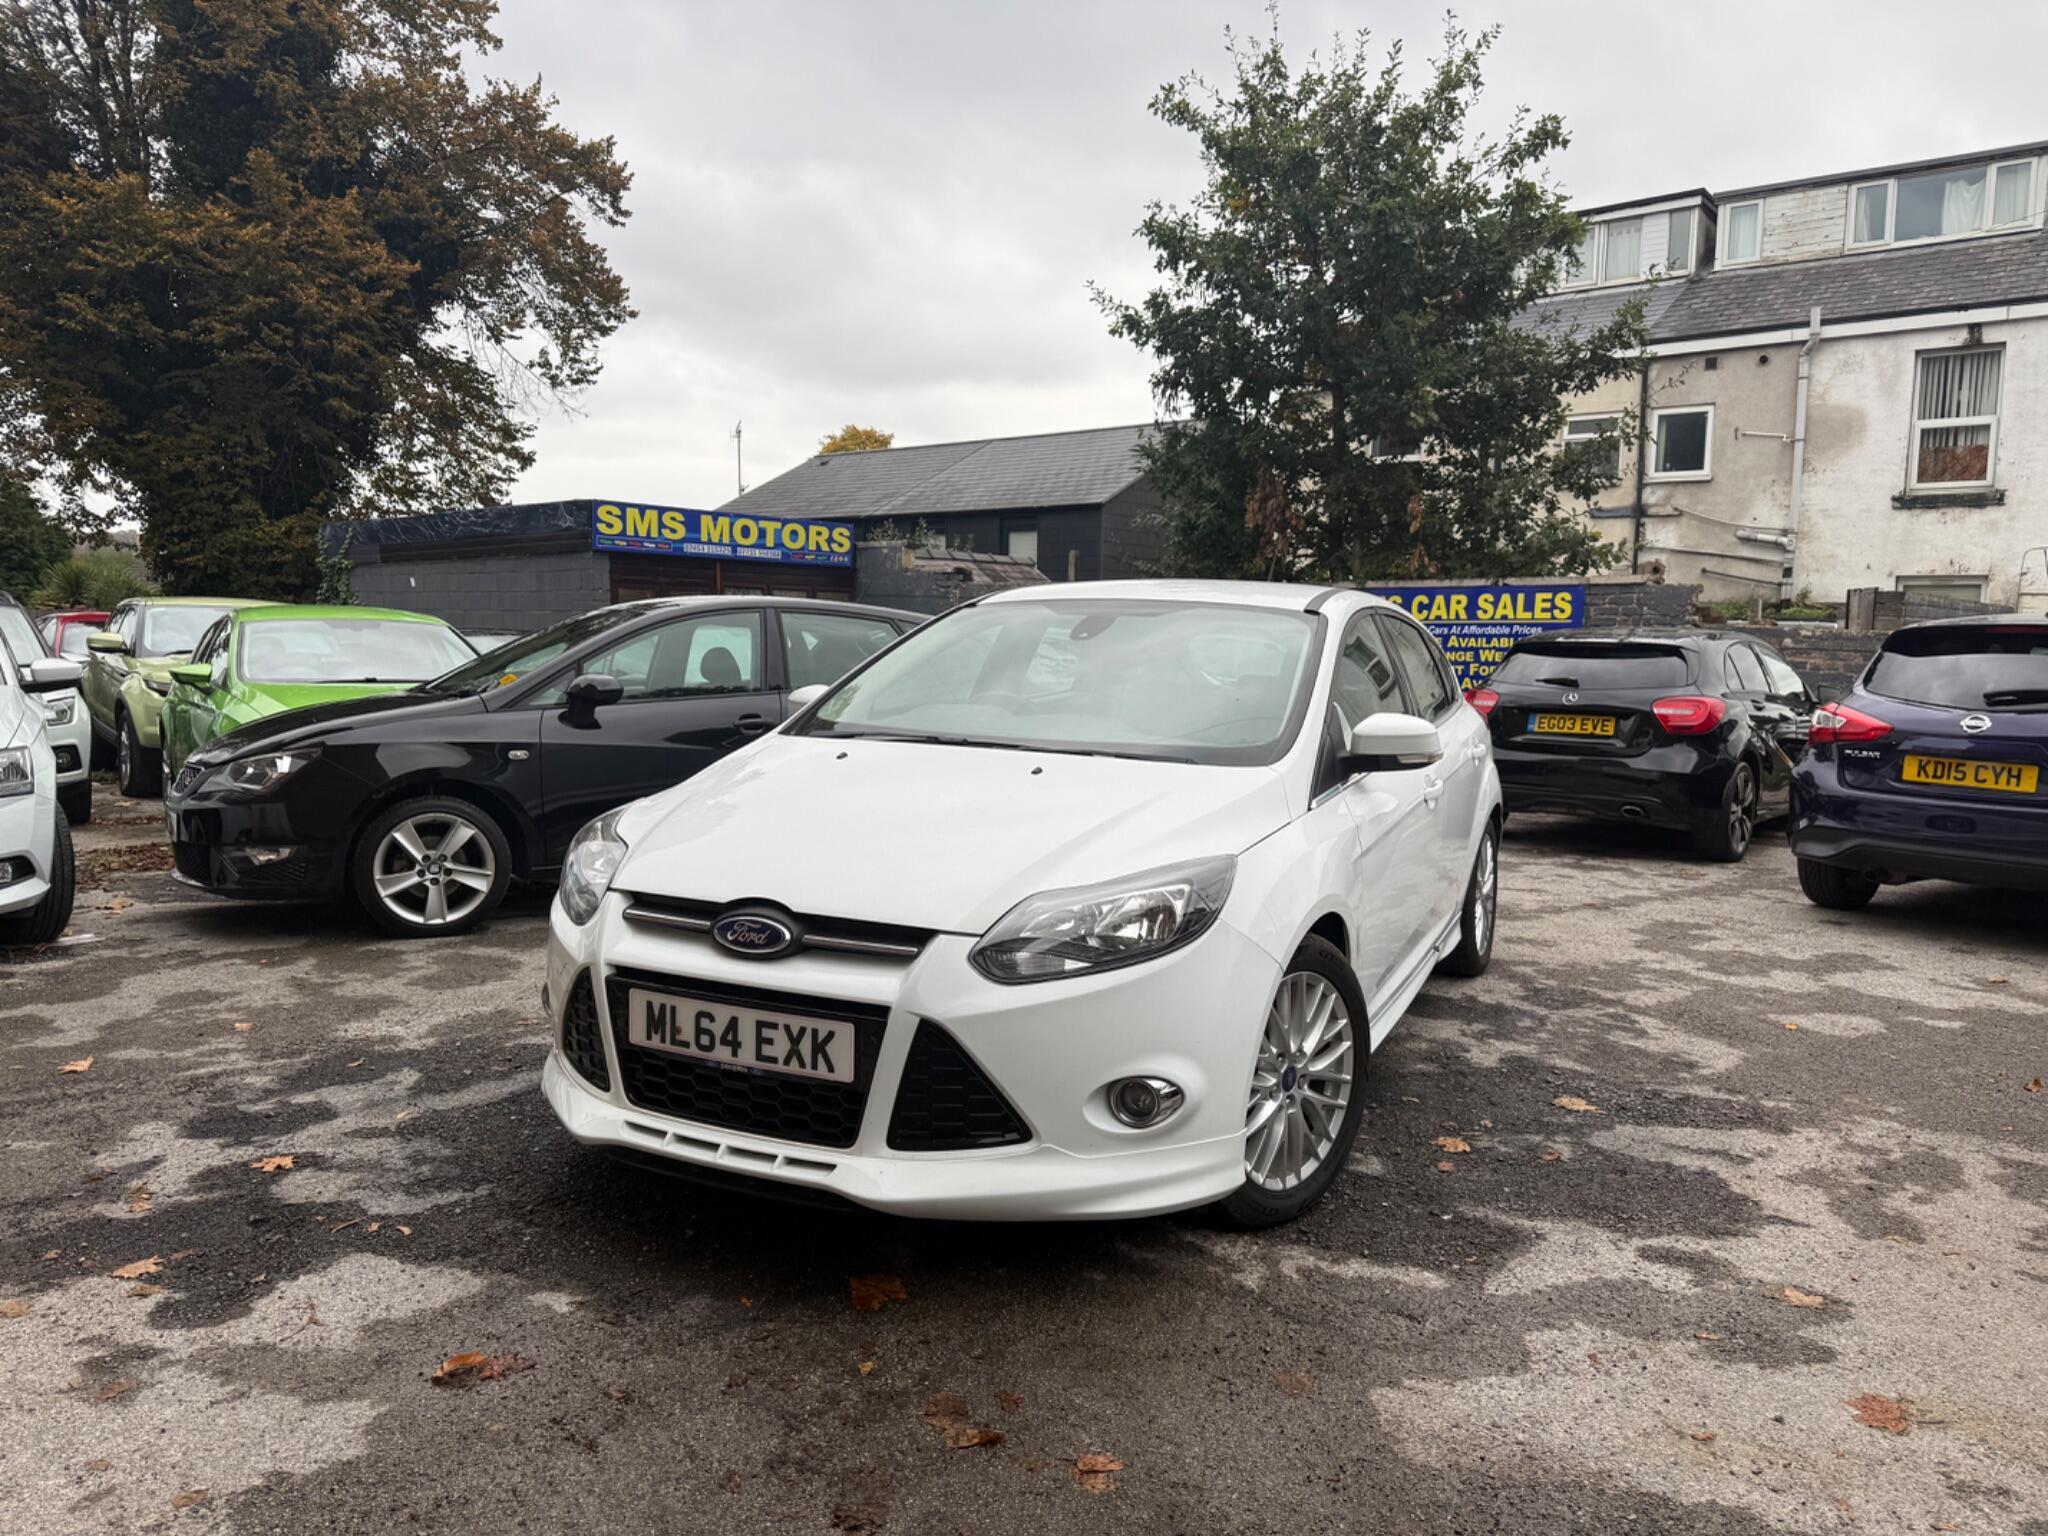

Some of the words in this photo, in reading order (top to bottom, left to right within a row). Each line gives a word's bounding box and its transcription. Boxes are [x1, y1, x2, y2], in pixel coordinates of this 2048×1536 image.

[596, 504, 686, 540] SMS
[700, 513, 851, 553] MOTORS
[1411, 594, 1468, 620] CAR
[1476, 591, 1573, 620] SALES
[1428, 625, 1448, 635] Cars
[1450, 625, 1461, 635] At
[1462, 624, 1511, 635] Affordable
[1512, 624, 1543, 635] Prices
[1537, 715, 1576, 731] EG03
[1580, 717, 1611, 733] EVE
[1916, 759, 1967, 782] KD15
[1974, 764, 2023, 787] CYH
[727, 921, 771, 944] Ford
[646, 1000, 742, 1058] ML64
[755, 1018, 836, 1074] EXK
